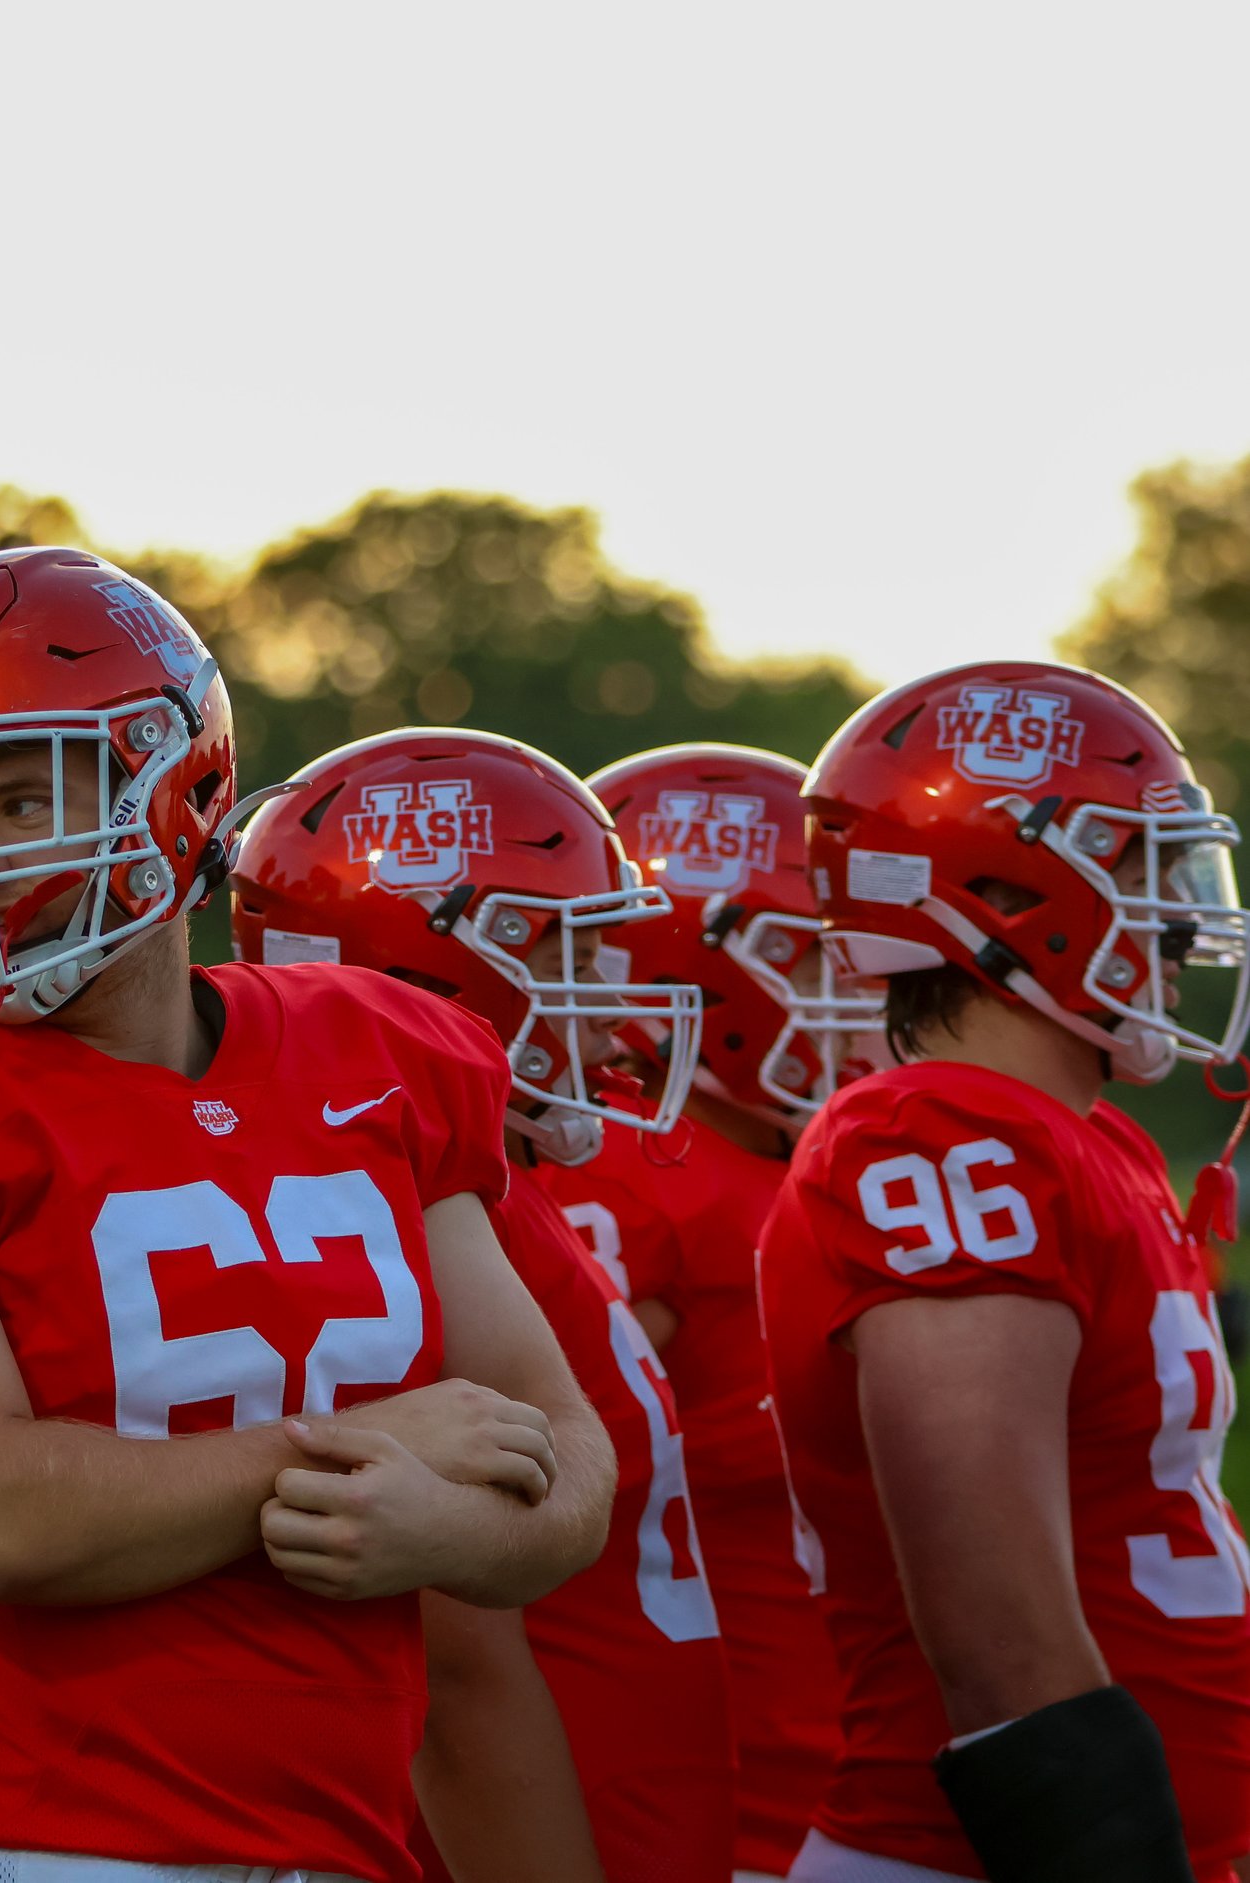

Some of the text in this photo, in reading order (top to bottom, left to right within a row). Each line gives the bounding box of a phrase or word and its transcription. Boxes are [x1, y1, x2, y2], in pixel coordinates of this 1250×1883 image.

[937, 707, 1084, 767] WASH
[959, 686, 1070, 790] U
[344, 805, 493, 862] WASH
[361, 780, 471, 894] U
[639, 813, 779, 873] WASH
[857, 1137, 1038, 1276] 96
[91, 1170, 423, 1440] 62
[1125, 1289, 1250, 1618] 9
